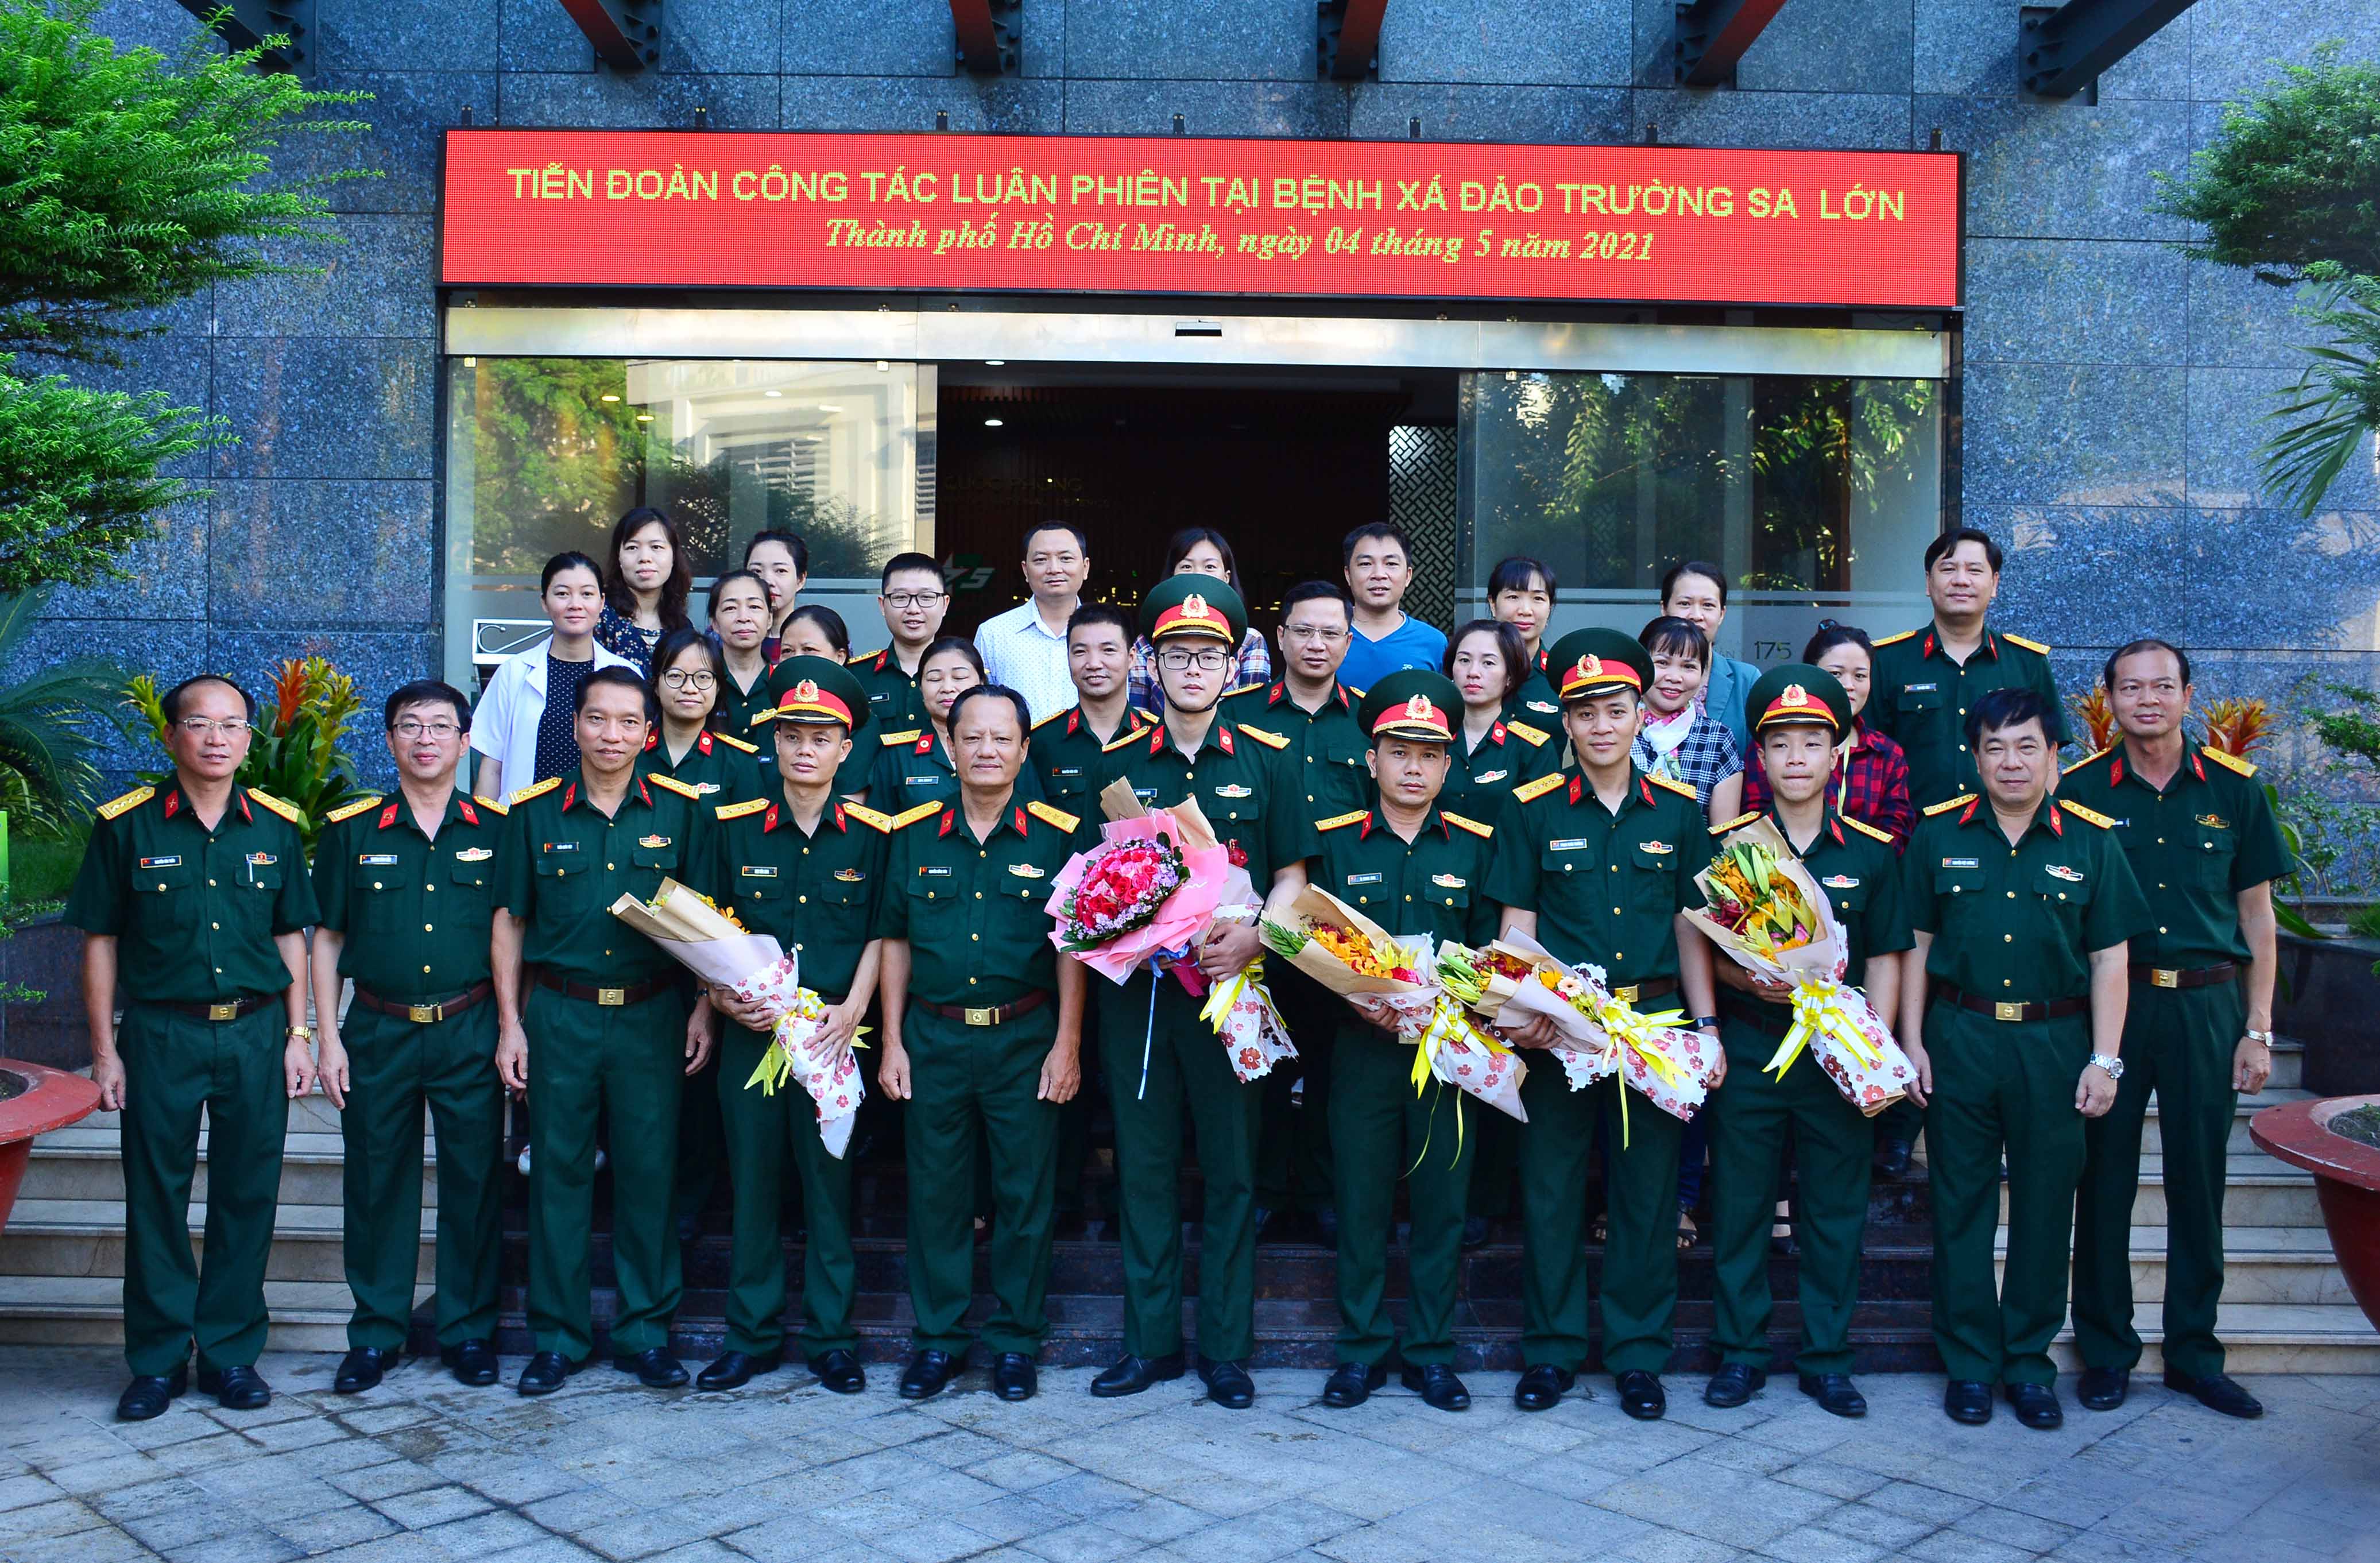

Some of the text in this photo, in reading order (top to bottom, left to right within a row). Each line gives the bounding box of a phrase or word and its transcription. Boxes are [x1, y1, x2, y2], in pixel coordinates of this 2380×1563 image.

[507, 163, 1903, 220] TIỄN ĐOÀN CÔNG TÁC LUÂN PHIÊN TẠI BỆNH XÁ ĐẢO TRƯỜNG SA LỚN
[827, 212, 1653, 263] Thành phố Hồ Chí Minh, ngày 04 tháng 5 năm 2021
[1754, 640, 1792, 660] 175
